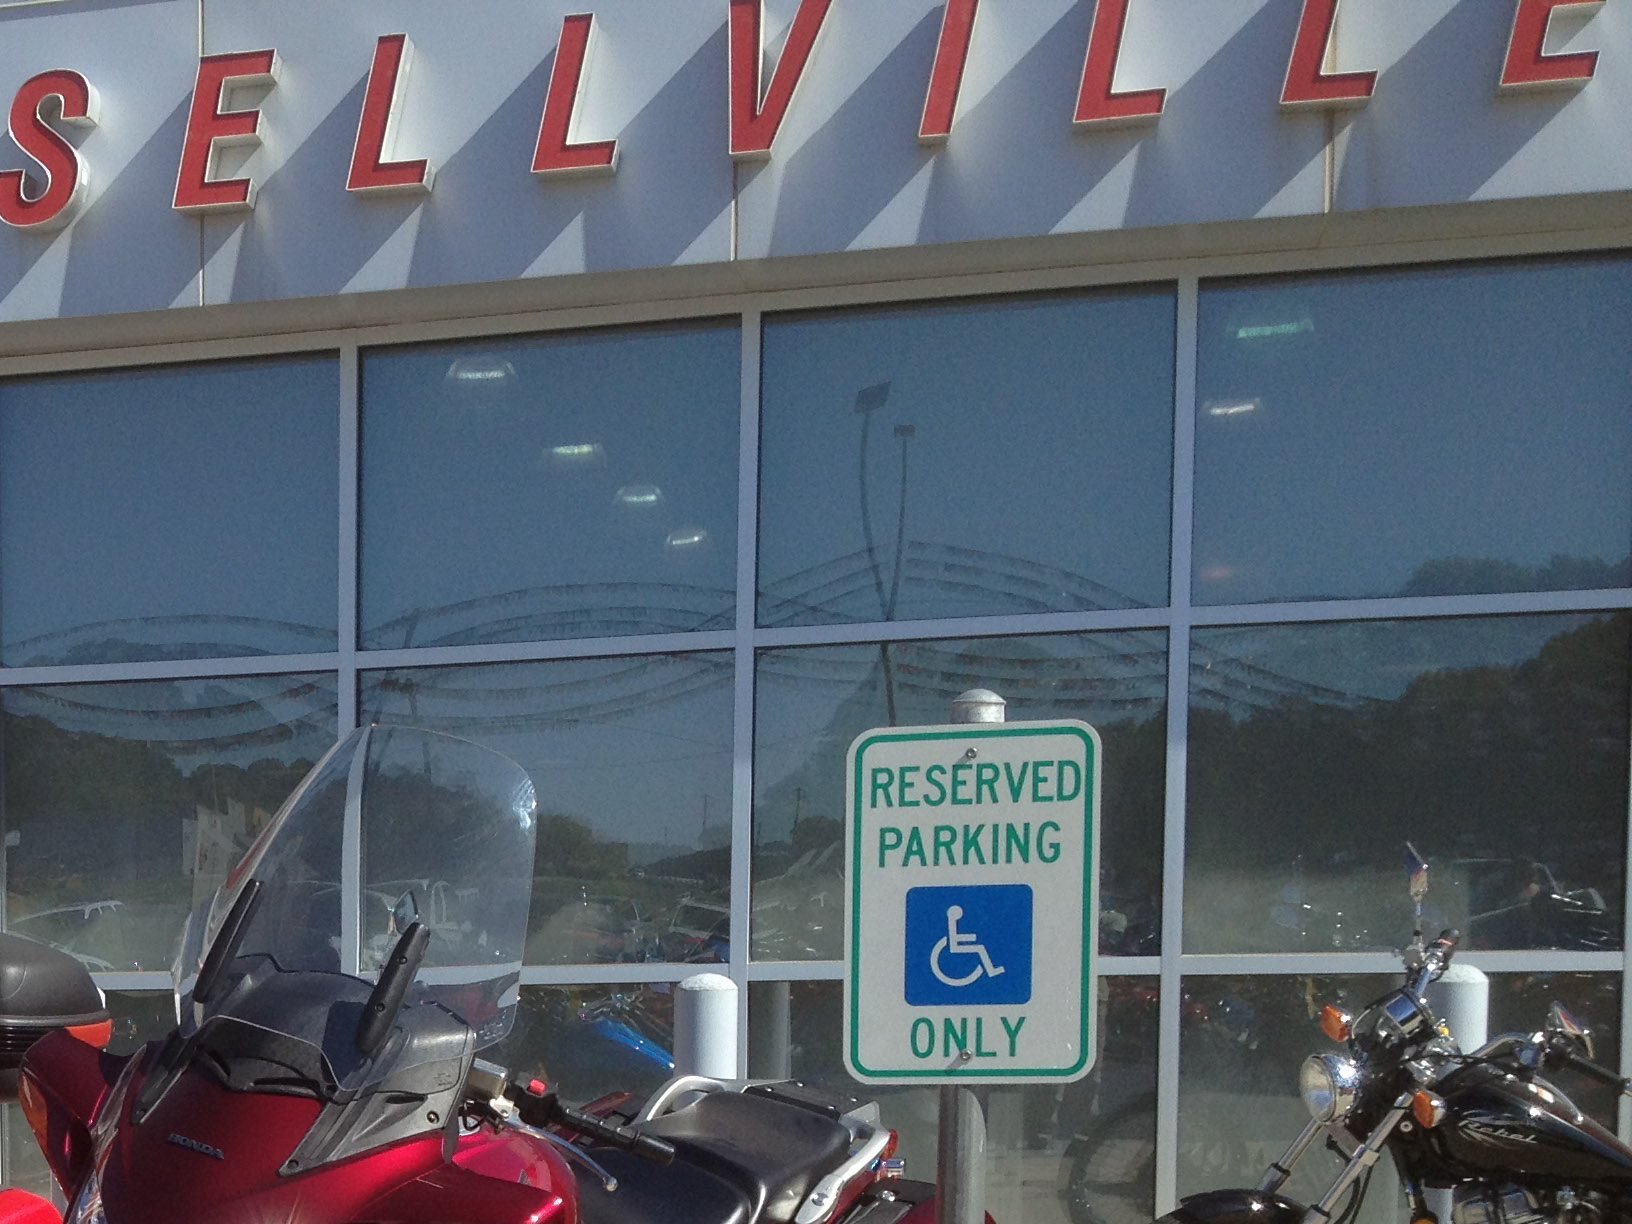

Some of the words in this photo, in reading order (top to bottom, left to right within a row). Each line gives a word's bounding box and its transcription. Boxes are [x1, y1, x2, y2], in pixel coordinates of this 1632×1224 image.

[870, 760, 1081, 809] RESERVED
[878, 820, 1061, 868] PARKING
[910, 1016, 1027, 1059] ONLY
[168, 1133, 225, 1161] HONDA
